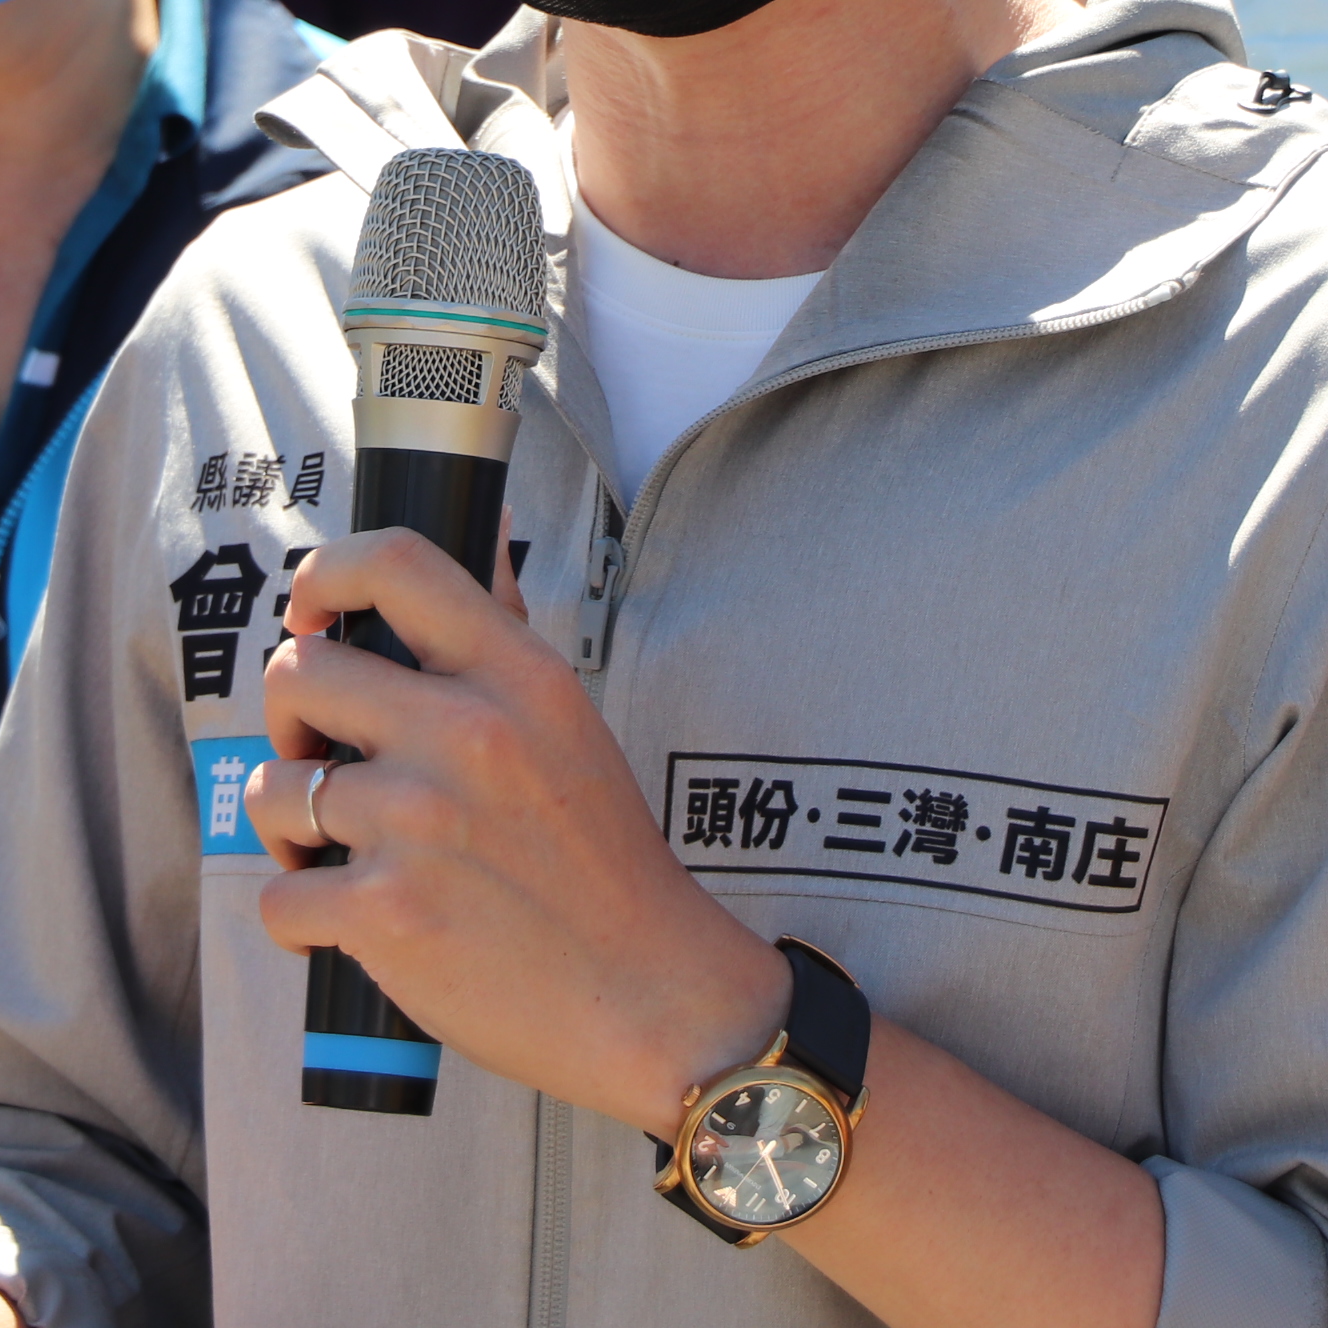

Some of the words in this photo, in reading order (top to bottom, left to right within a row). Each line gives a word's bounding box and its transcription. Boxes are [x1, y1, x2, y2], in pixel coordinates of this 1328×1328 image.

[190, 451, 325, 513] 縣議員
[734, 1091, 752, 1107] 4
[697, 1135, 716, 1152] 2
[815, 1148, 832, 1165] 8
